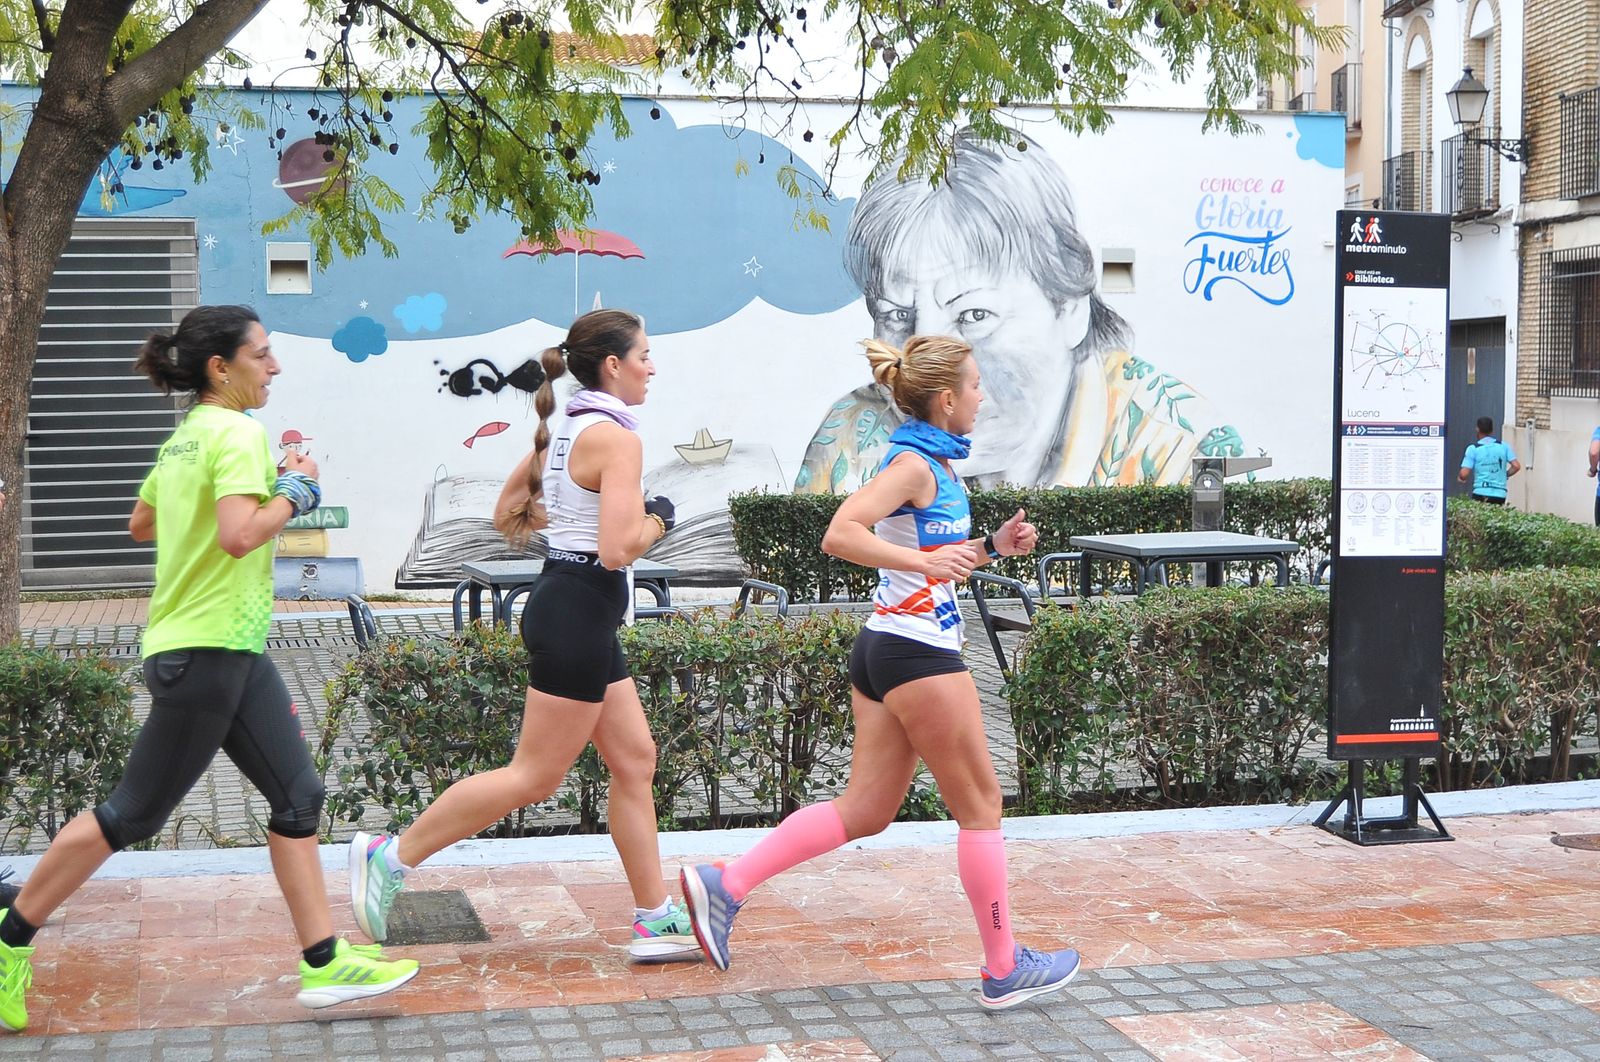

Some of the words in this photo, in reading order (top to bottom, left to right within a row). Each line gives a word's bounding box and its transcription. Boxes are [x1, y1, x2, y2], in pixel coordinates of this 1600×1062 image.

[1200, 178, 1263, 193] conoce
[1271, 179, 1285, 193] a
[1195, 194, 1284, 230] Gloria
[1346, 243, 1407, 255] metrominuto
[1183, 225, 1295, 306] Fuertes
[1354, 274, 1395, 284] Biblioteca
[1347, 408, 1381, 418] Lucena
